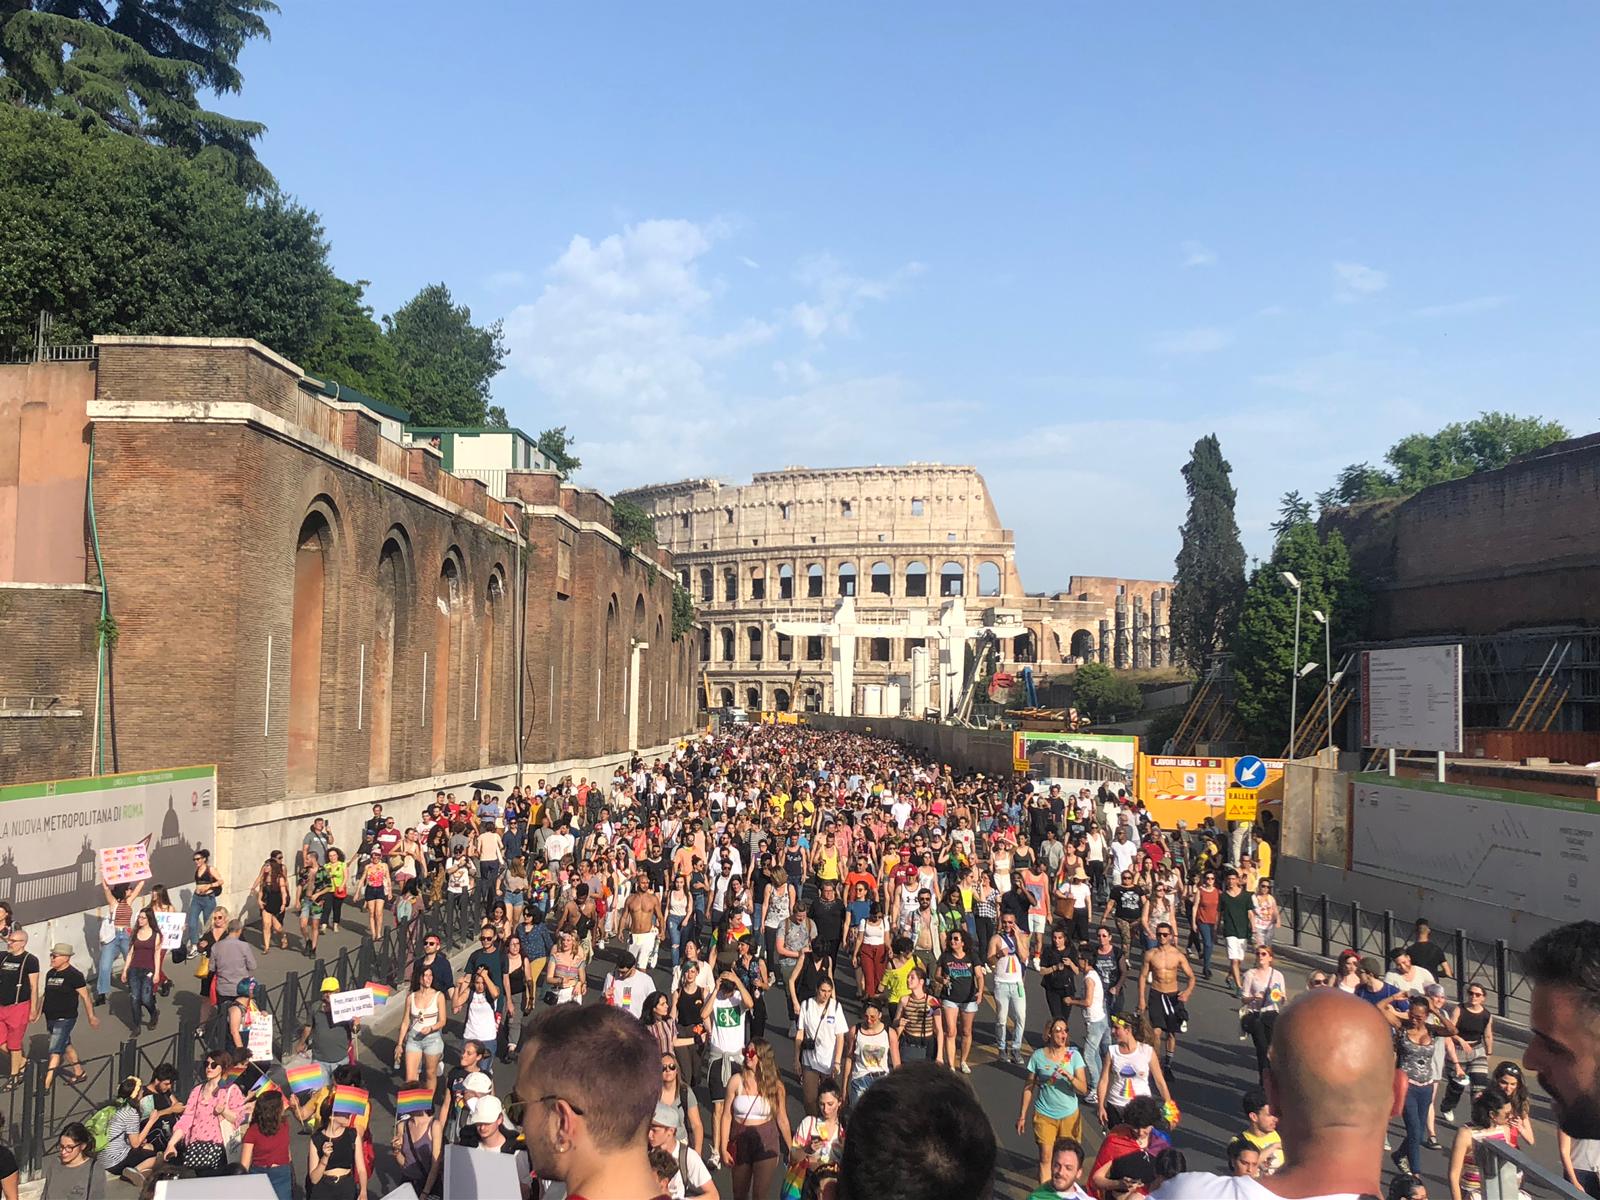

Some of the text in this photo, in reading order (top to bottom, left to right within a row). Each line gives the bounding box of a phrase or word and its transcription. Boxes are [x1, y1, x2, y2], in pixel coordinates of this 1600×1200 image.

[11, 818, 42, 837] NUOVA
[44, 808, 112, 832] METROPOLITANA
[114, 806, 121, 821] DI
[123, 803, 143, 819] ROMA
